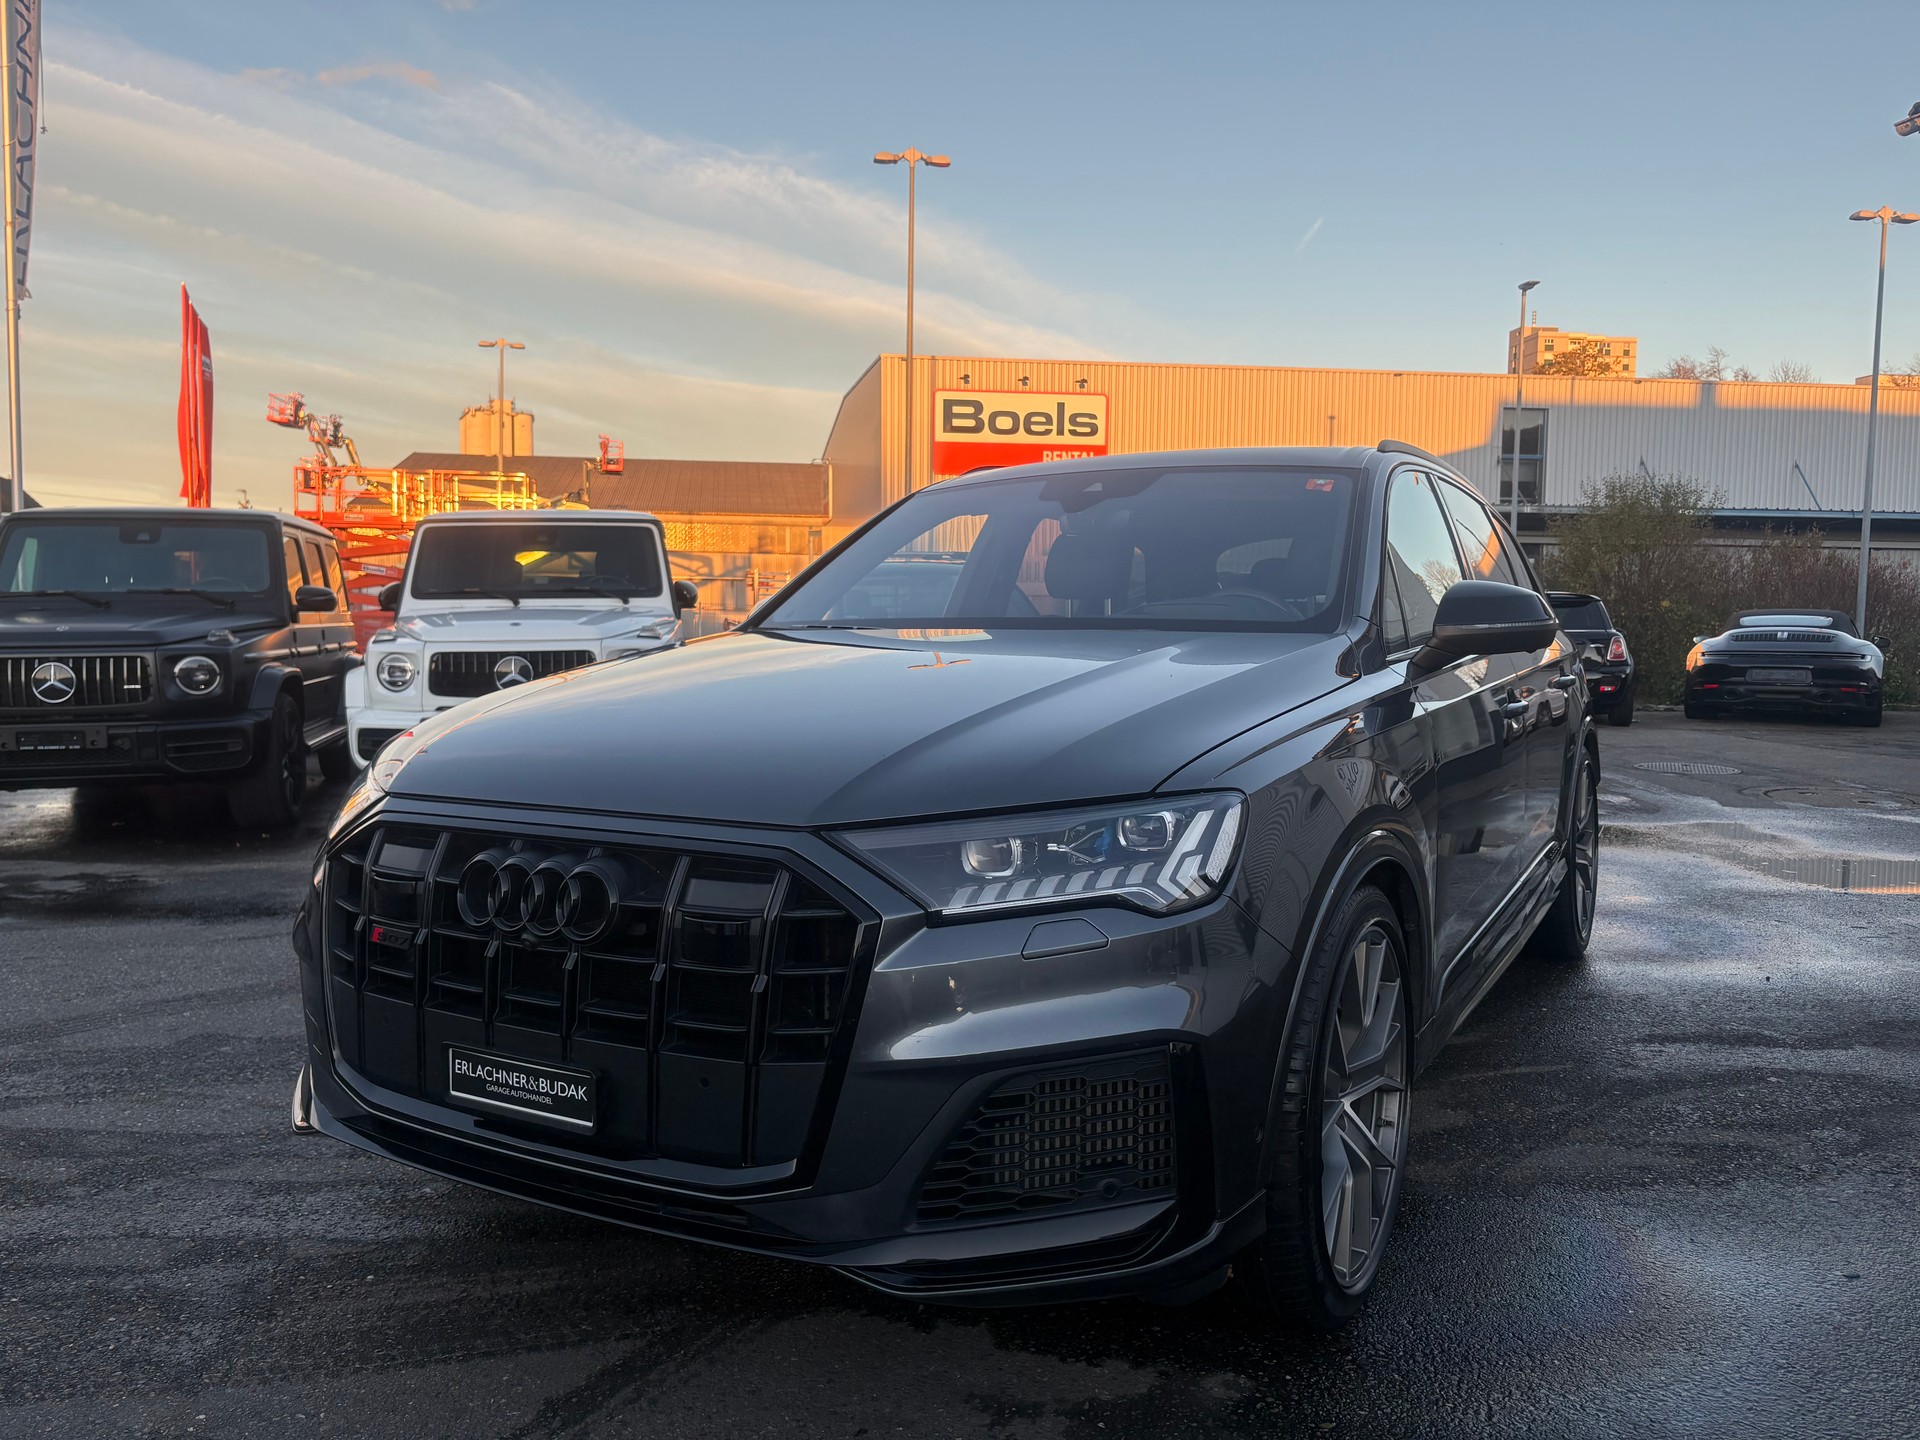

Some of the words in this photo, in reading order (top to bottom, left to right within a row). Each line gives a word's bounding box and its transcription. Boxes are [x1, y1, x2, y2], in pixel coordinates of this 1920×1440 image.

[943, 398, 1099, 437] Boels
[485, 1083, 510, 1096] GARAGE
[510, 1089, 553, 1105] AUTOHANDEL
